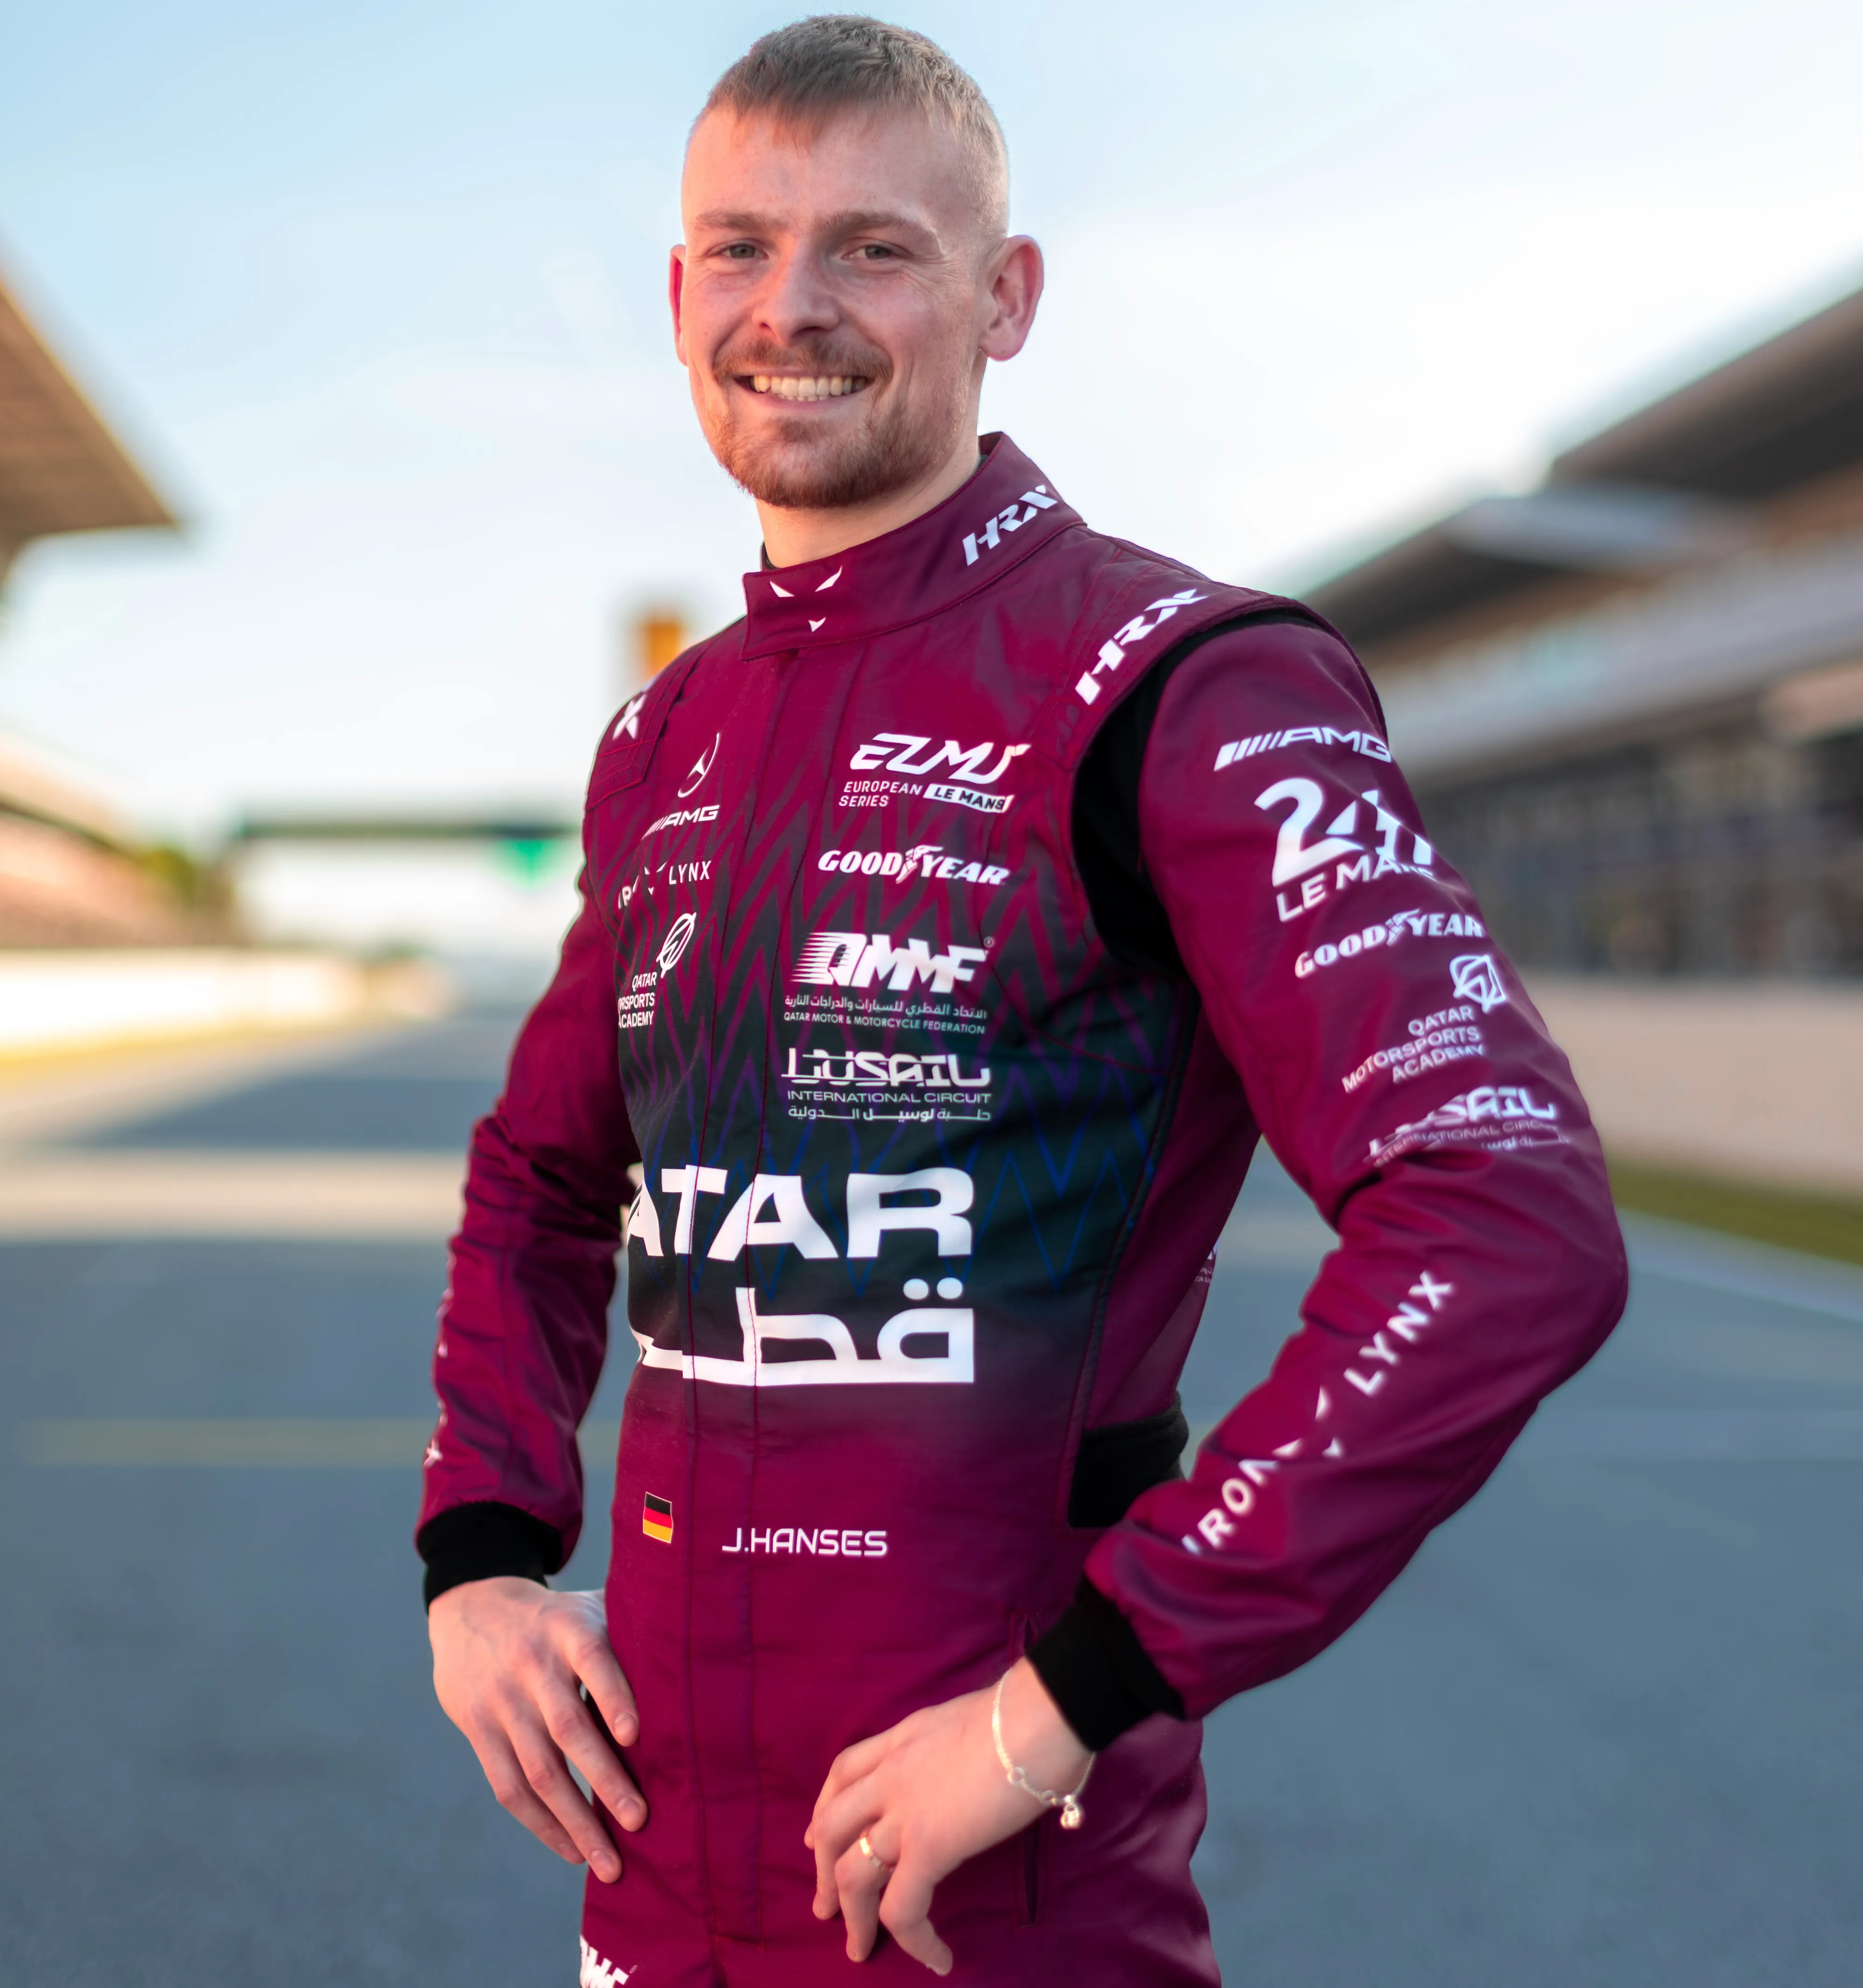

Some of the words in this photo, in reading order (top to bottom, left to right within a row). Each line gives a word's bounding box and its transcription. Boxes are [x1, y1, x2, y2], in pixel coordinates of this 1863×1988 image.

[962, 484, 1058, 566] HRX
[1075, 589, 1208, 705] HRX
[1277, 727, 1392, 763] AMG
[839, 795, 890, 807] SERIES
[843, 781, 923, 796] EUROPEAN
[934, 786, 952, 799] LE
[958, 790, 1005, 810] MANS
[660, 804, 721, 830] AMG
[669, 860, 712, 885] LYNX
[818, 845, 1010, 885] GOODYEAR
[1276, 872, 1326, 923] LE
[1295, 908, 1485, 978] GOODYEAR
[790, 932, 987, 994] QMMF
[632, 971, 657, 992] QATAR
[785, 994, 809, 1008] النارية
[810, 995, 853, 1011] والدراجات
[855, 999, 904, 1014] للسيارات
[905, 1002, 950, 1018] القطري
[952, 1005, 987, 1019] الاتحاد
[784, 1012, 809, 1021] QATAR
[812, 1013, 843, 1024] MOTOR
[845, 1015, 851, 1024] &
[854, 1016, 920, 1029] MOTORCYCLE
[923, 1020, 986, 1035] FEDERATION
[1407, 1005, 1475, 1037] QATAR
[781, 1048, 991, 1087] LUSAIL
[1341, 1025, 1481, 1094] MOTORSPORTS
[787, 1090, 921, 1103] INTERNATIONAL
[924, 1093, 991, 1103] CIRCUIT
[627, 1162, 974, 1262] ATAR
[1343, 1269, 1453, 1396] LYNX
[721, 1527, 888, 1557] J.HANSES
